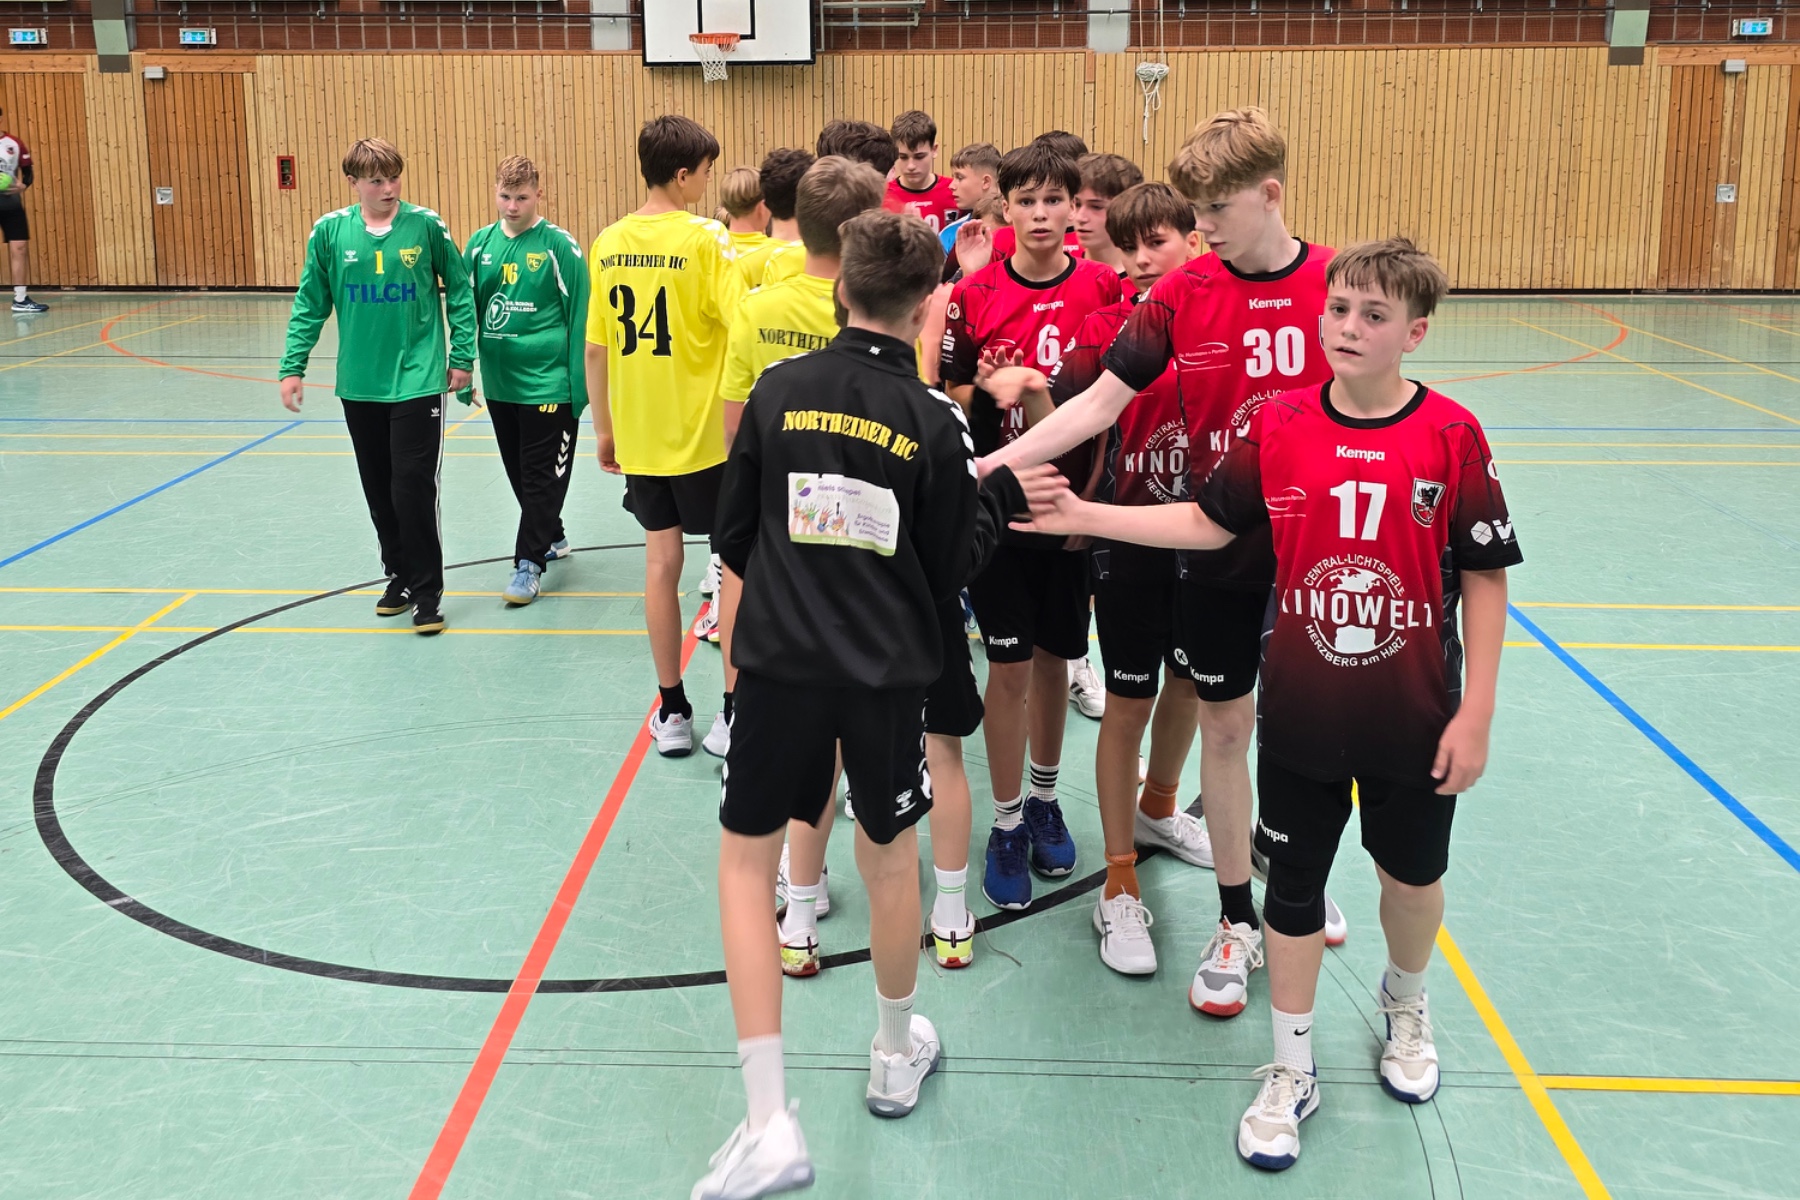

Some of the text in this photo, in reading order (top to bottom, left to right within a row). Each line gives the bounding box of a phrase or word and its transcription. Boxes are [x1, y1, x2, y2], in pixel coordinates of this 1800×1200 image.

[375, 251, 384, 274] 1
[502, 262, 518, 284] 16
[600, 254, 688, 272] NORTHEIMER HC
[346, 283, 416, 304] TILCH
[1249, 298, 1292, 310] Kempa
[1033, 300, 1064, 313] Kempa
[609, 284, 672, 357] 34
[1037, 324, 1060, 367] 6
[1243, 326, 1306, 378] 30
[782, 410, 919, 461] NORTHEIMER HC
[1125, 449, 1186, 475] KINO
[1336, 445, 1385, 462] Kempa
[1330, 480, 1388, 541] 17
[1305, 624, 1407, 667] HERZBERG am HARZ
[1114, 669, 1149, 683] Kempa
[1260, 817, 1288, 843] mpa
